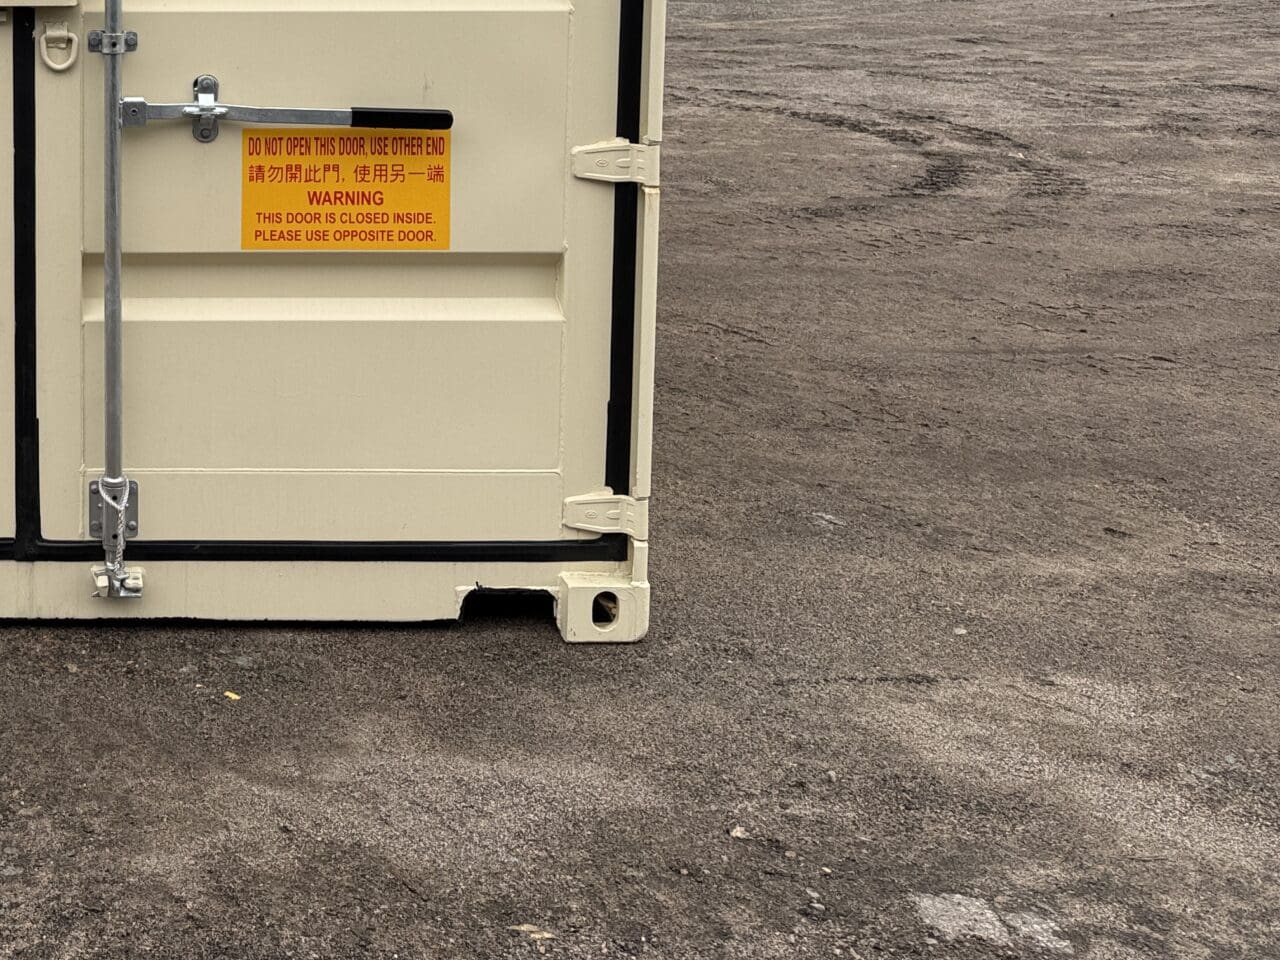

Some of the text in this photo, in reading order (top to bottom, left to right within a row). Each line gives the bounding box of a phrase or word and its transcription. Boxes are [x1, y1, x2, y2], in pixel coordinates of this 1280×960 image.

[248, 136, 445, 158] DO NOT OPEN THIS DOOR, USE OTHER END
[308, 191, 384, 206] WARNING
[256, 213, 436, 224] THIS DOOR IS CLOSED INSIDE.
[254, 230, 437, 242] PLEASE USE OPPOSITE DOOR.
